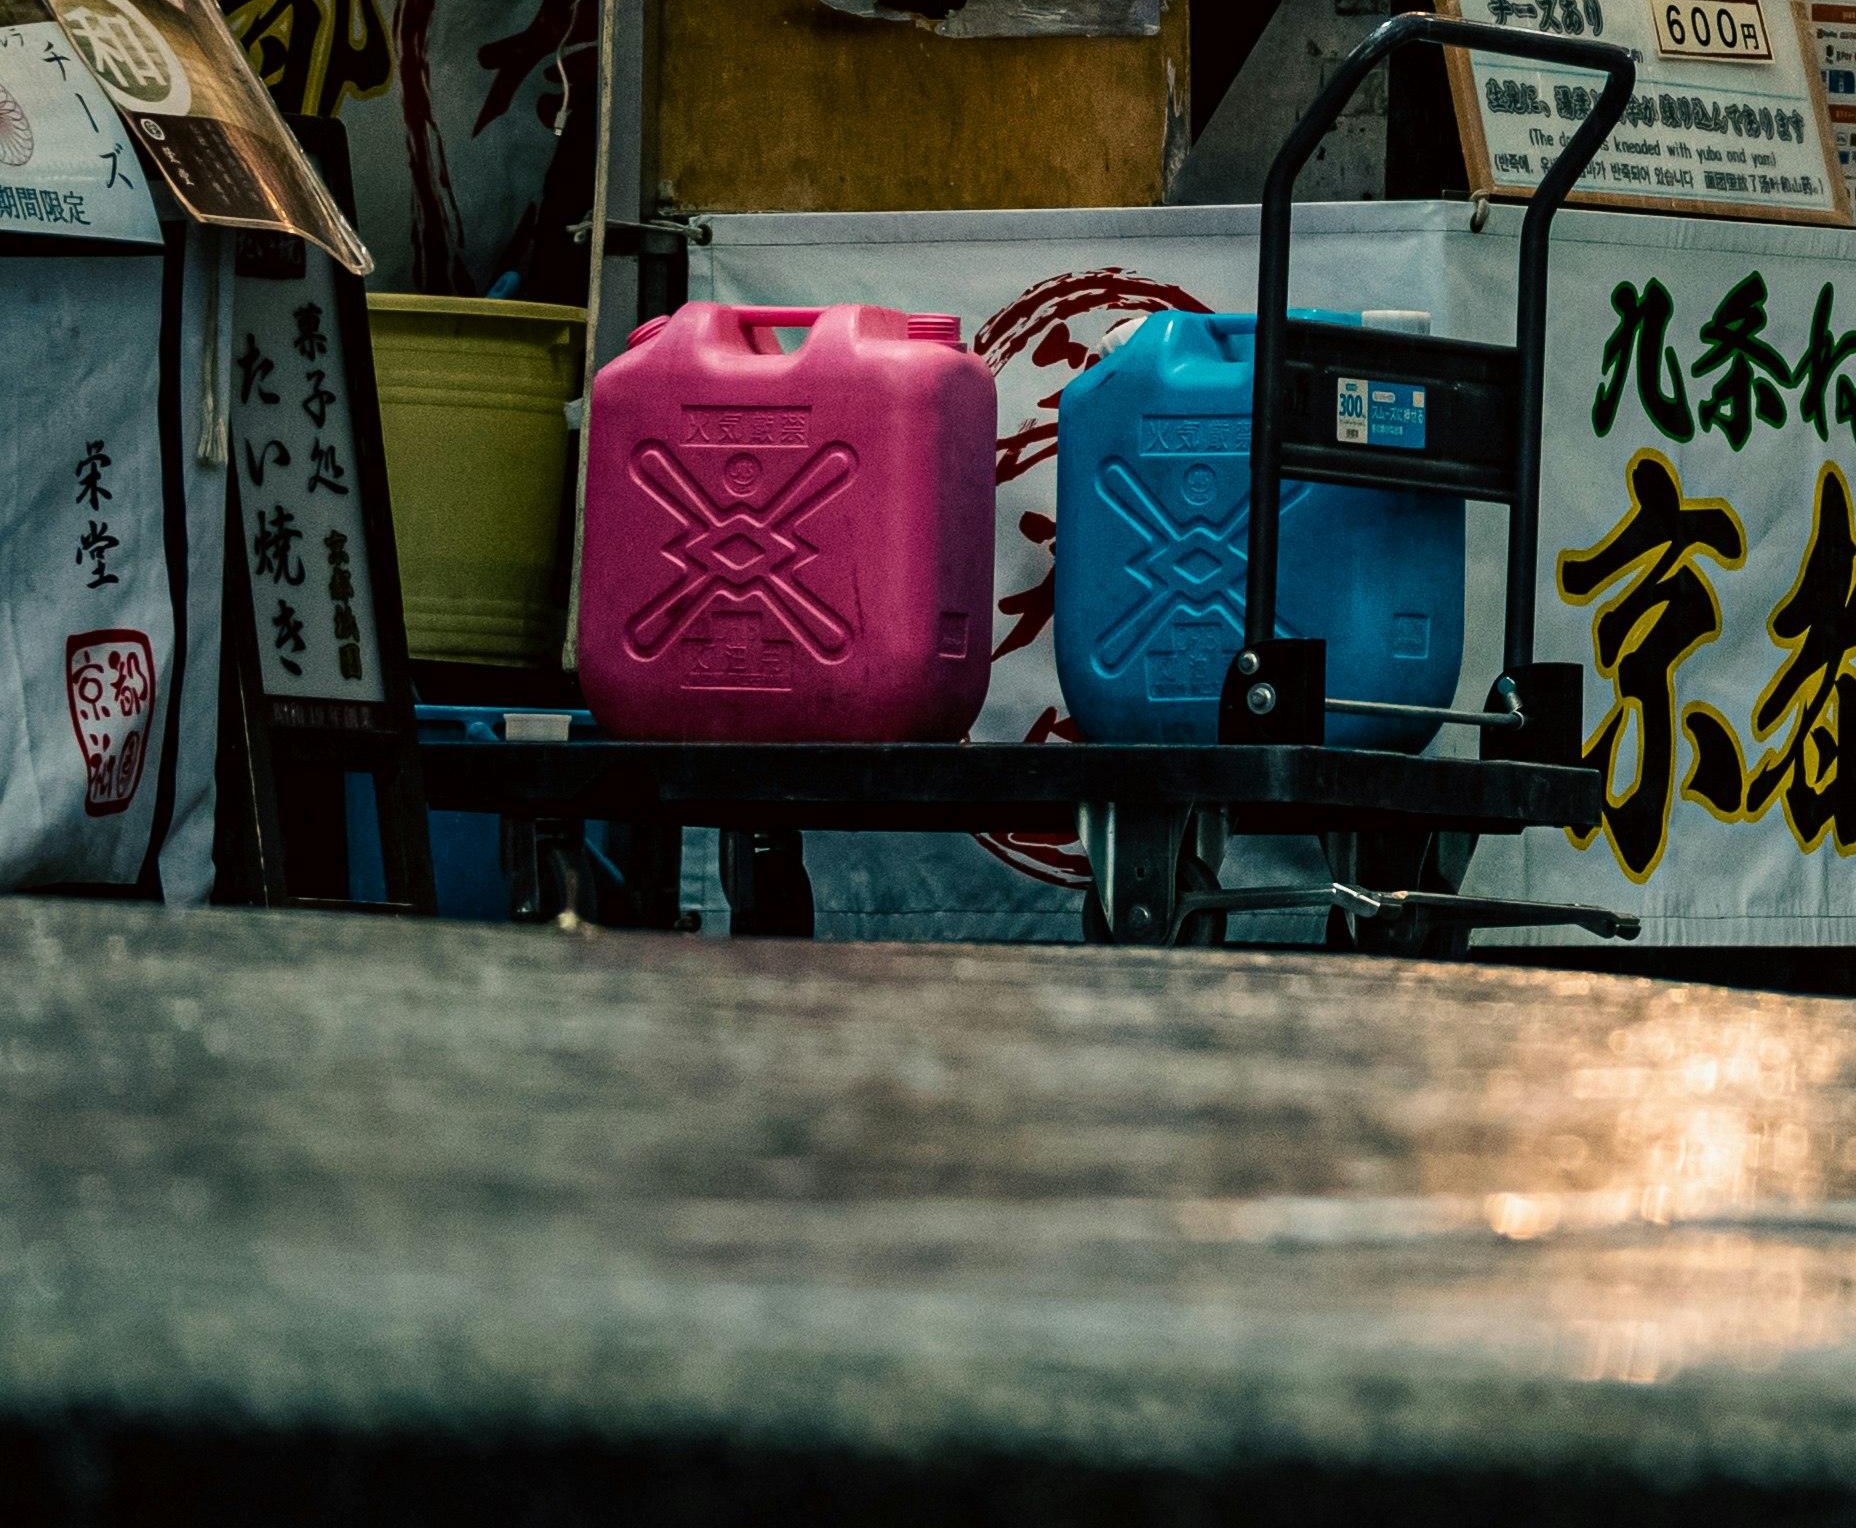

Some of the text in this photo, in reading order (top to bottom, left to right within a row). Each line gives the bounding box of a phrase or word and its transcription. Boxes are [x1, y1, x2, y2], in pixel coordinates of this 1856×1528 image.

[1664, 3, 1760, 51] 600円
[1614, 135, 1661, 158] kneaded
[1667, 141, 1692, 160] with
[1696, 146, 1723, 165] yuba
[1725, 148, 1747, 164] and
[293, 302, 350, 496] 菓子処
[1339, 393, 1363, 418] 300
[75, 439, 121, 590] 栄堂
[236, 333, 306, 675] たい焼き
